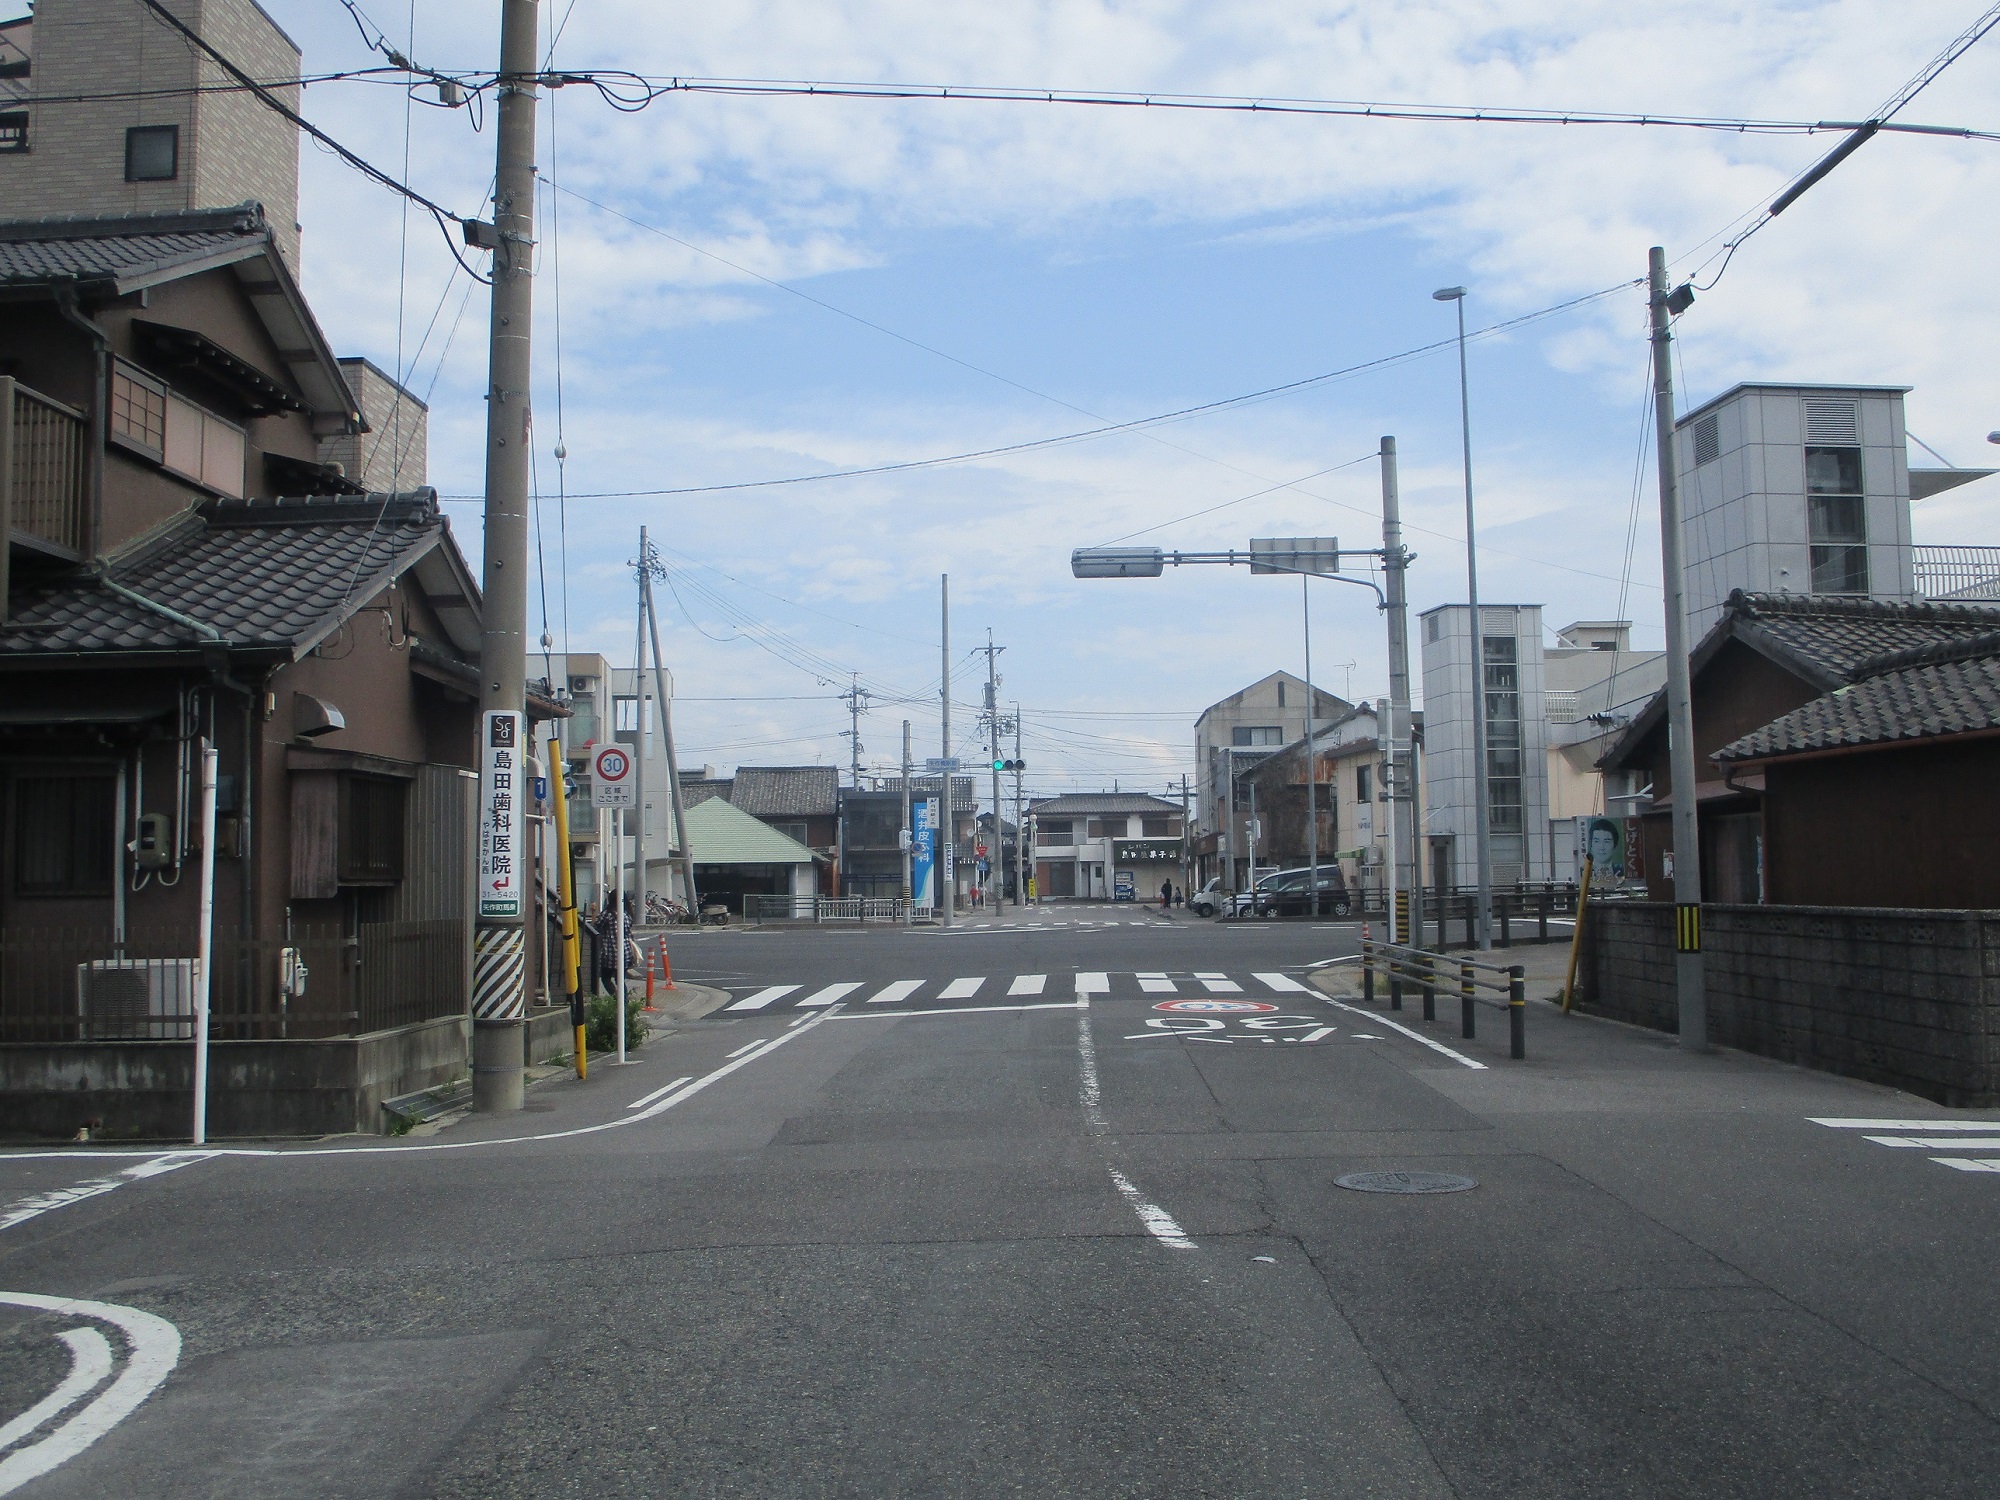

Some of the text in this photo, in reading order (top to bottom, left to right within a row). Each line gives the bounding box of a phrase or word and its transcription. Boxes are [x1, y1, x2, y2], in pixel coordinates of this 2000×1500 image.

[603, 758, 622, 773] 30
[537, 780, 543, 795] 1
[492, 751, 512, 874] 島田歯科医院
[917, 808, 930, 863] 酒井皮ふ科
[1625, 820, 1639, 870] しげとく
[1145, 1016, 1324, 1030] 30
